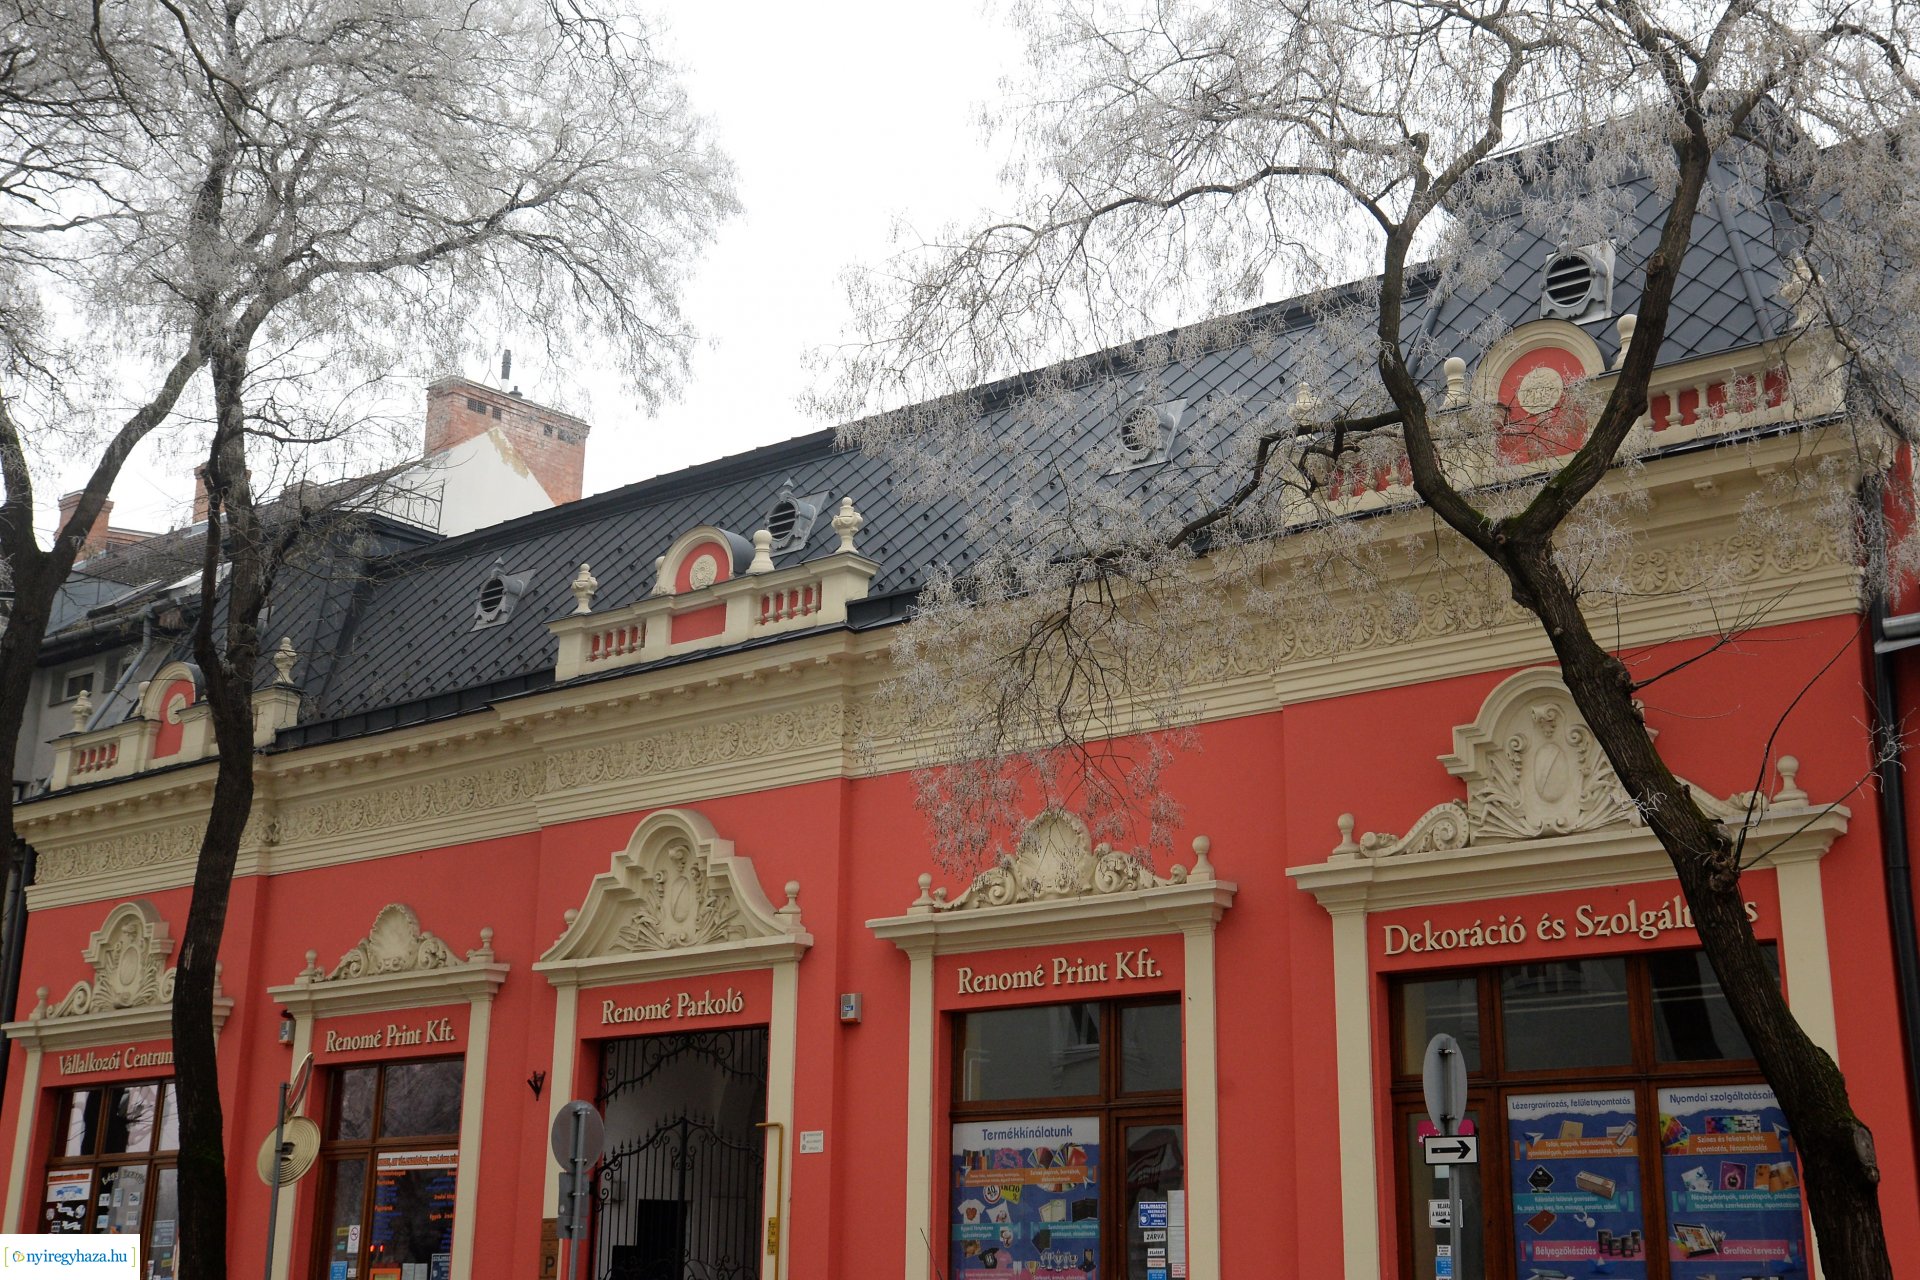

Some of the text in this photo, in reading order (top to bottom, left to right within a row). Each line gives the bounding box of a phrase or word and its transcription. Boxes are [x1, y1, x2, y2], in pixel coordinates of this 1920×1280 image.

[1383, 894, 1759, 955] Dekoráció és Szolgálts
[957, 948, 1163, 994] Renomé Print Kft.
[601, 987, 744, 1024] Renomé Parkoló
[325, 1018, 456, 1052] Renomé Print Kft.
[59, 1051, 121, 1075] Vállalkozói
[1669, 1092, 1708, 1105] Nyomdai
[982, 1125, 1073, 1141] Termékkínálatunk
